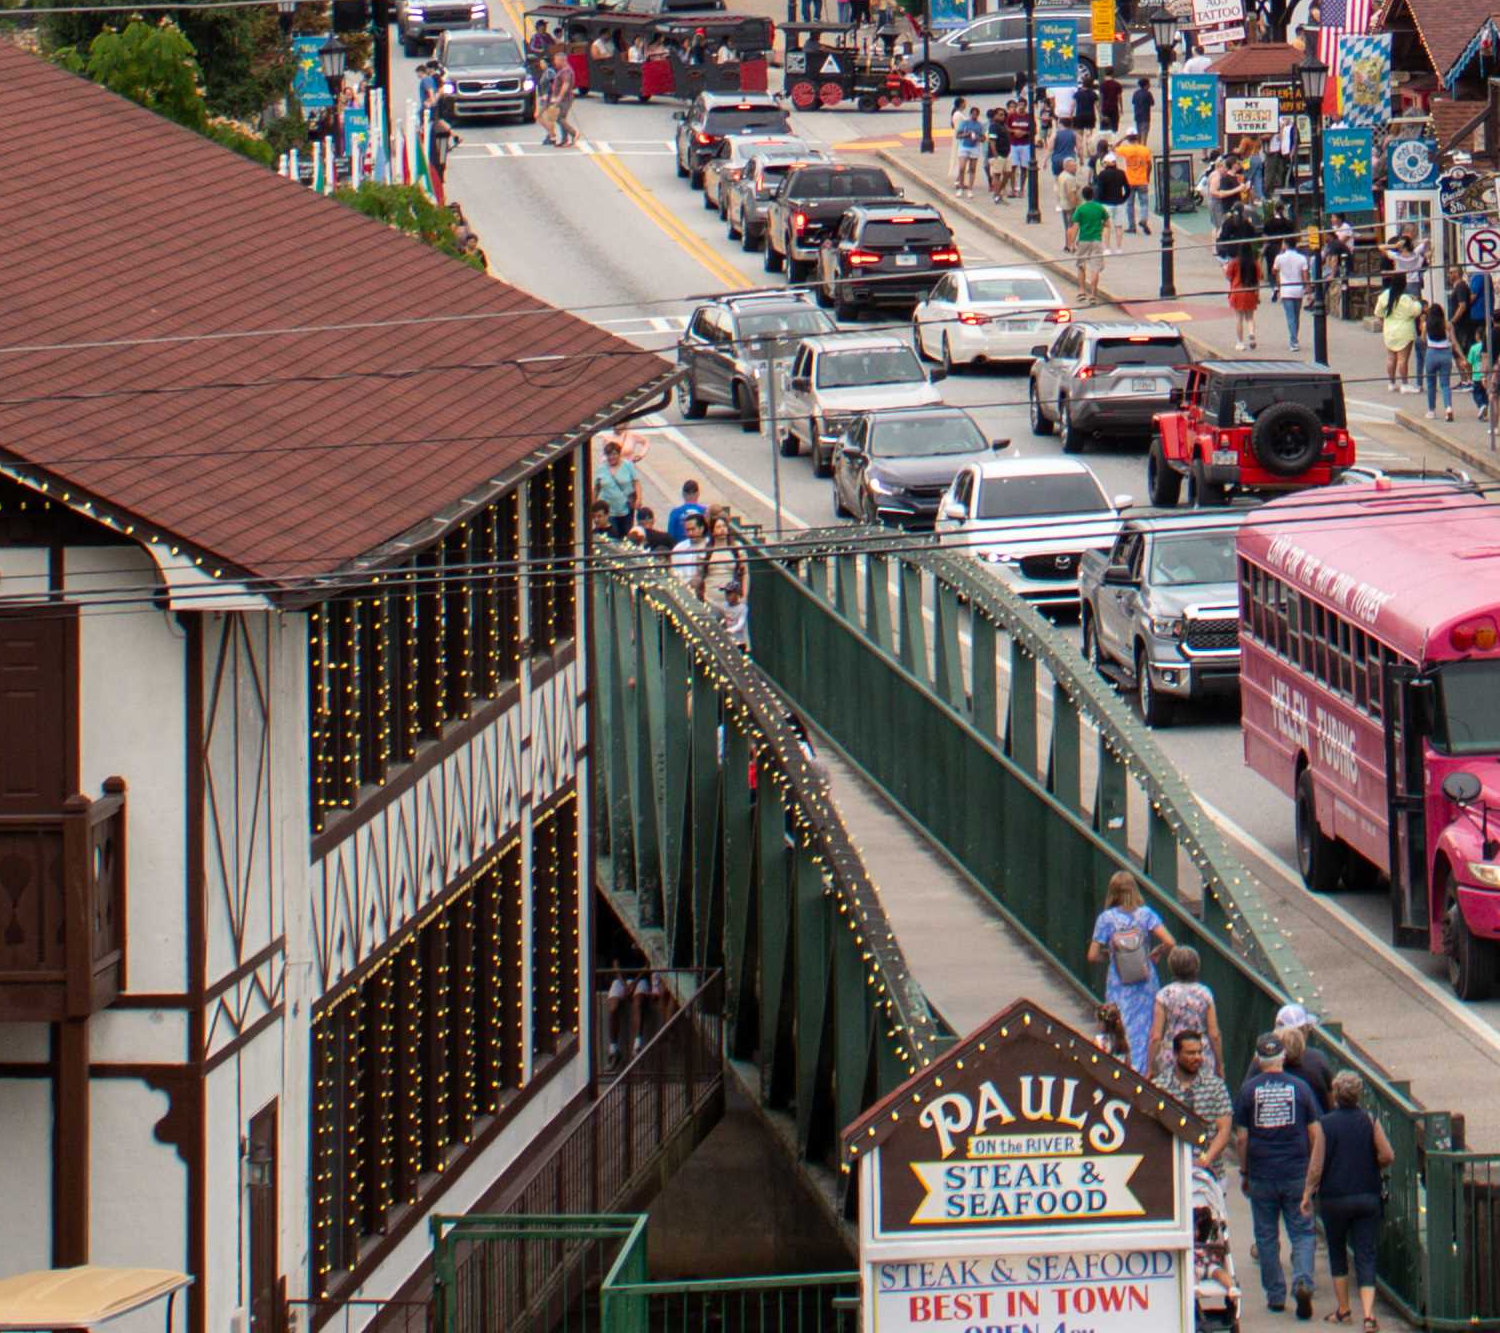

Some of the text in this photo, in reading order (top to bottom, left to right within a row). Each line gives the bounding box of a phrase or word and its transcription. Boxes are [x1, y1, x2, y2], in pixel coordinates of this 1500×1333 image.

[1197, 6, 1241, 22] TATTOO
[1176, 79, 1213, 92] Welcome
[1244, 101, 1260, 110] MY
[1236, 122, 1268, 131] STORE
[1327, 135, 1365, 148] Welcome
[1270, 675, 1359, 785] HELEN TUBING
[918, 1074, 1132, 1161] PAUL'S
[974, 1137, 1077, 1154] ON the RIVER
[946, 1160, 1106, 1191] STEAK &
[947, 1189, 1108, 1218] SEAFOOD
[880, 1250, 1174, 1289] STEAK & SEAFOOD
[908, 1284, 1150, 1323] BEST IN TOWN
